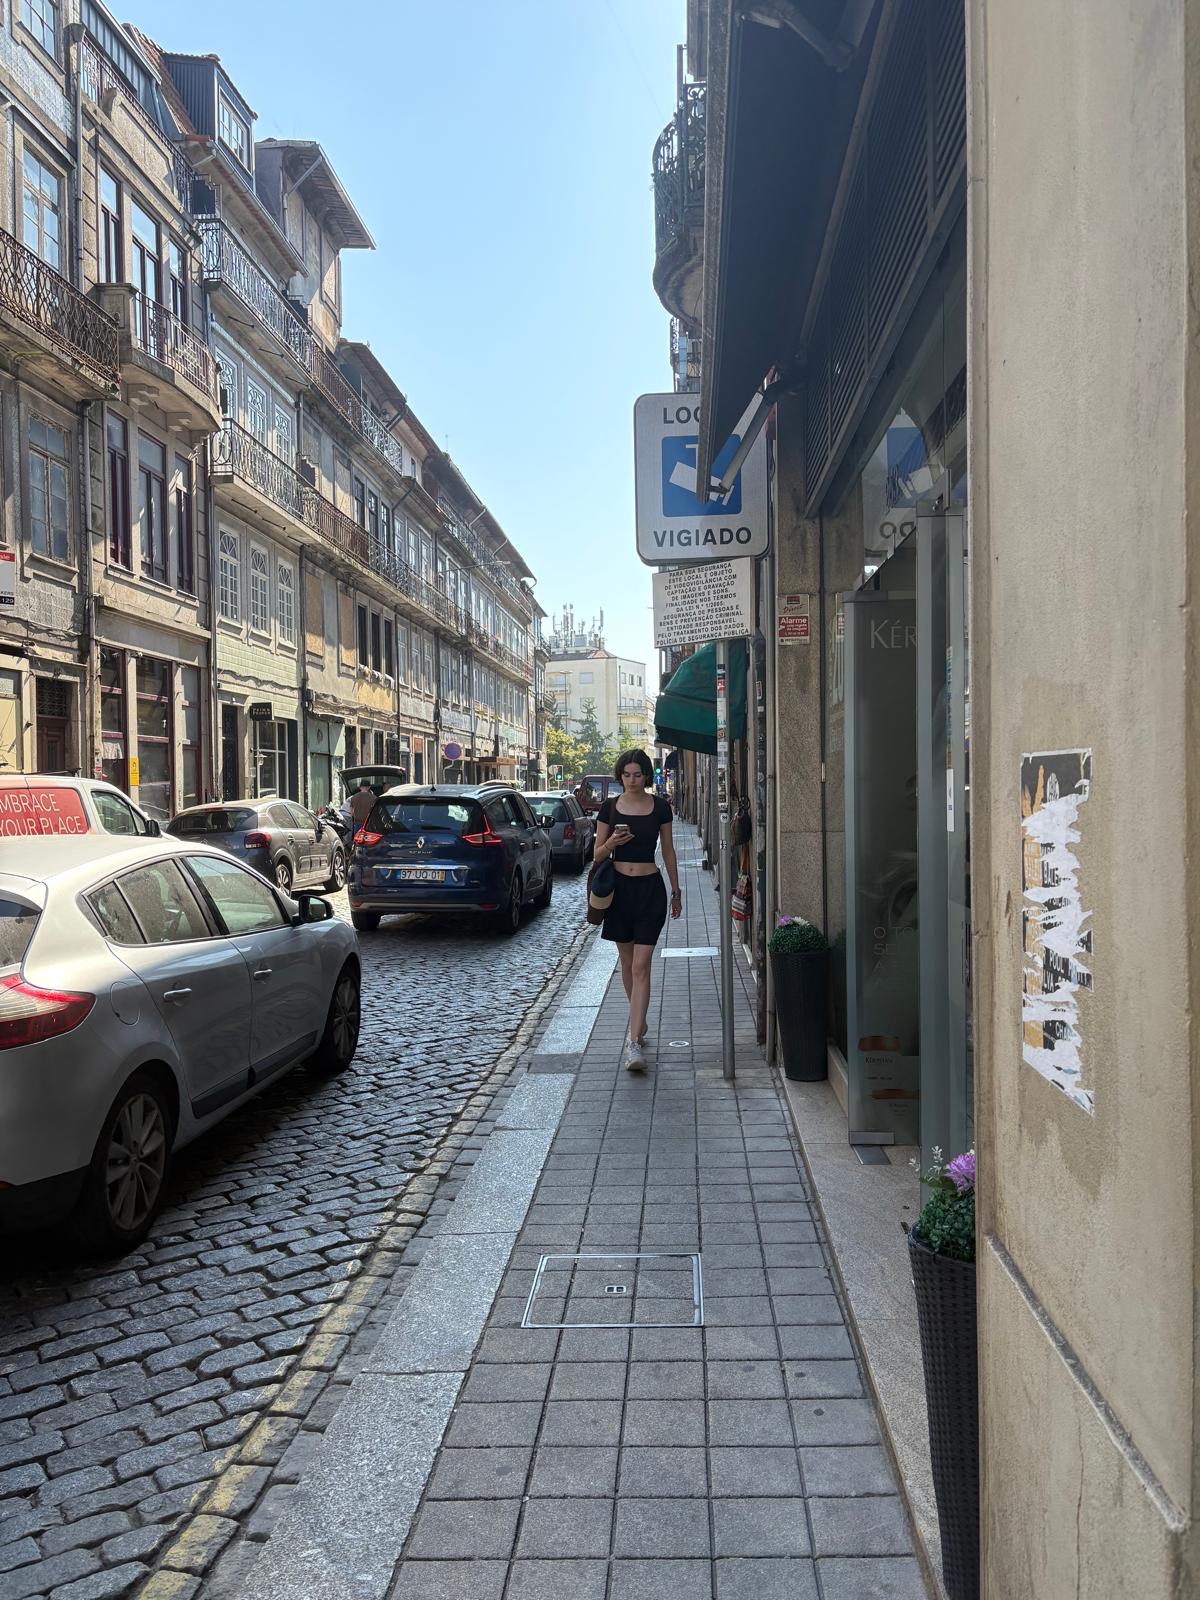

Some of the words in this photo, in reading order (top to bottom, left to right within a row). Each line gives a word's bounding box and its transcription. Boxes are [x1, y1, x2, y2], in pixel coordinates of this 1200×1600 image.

[654, 527, 752, 548] VIGIADO
[698, 563, 731, 573] SEGURANÇA
[710, 569, 732, 577] OBJETO
[667, 586, 696, 596] CAPTAÇÃO
[704, 581, 734, 590] GRAVAÇÃO
[666, 600, 697, 608] FINALIDADE
[664, 611, 696, 620] SEGURANÇA
[681, 614, 713, 623] PREVENÇÃO
[673, 628, 708, 636] TRATAMENTO
[657, 637, 677, 645] POLÍCIA
[688, 632, 721, 641] SEGURANÇA
[40, 816, 83, 834] PLACE
